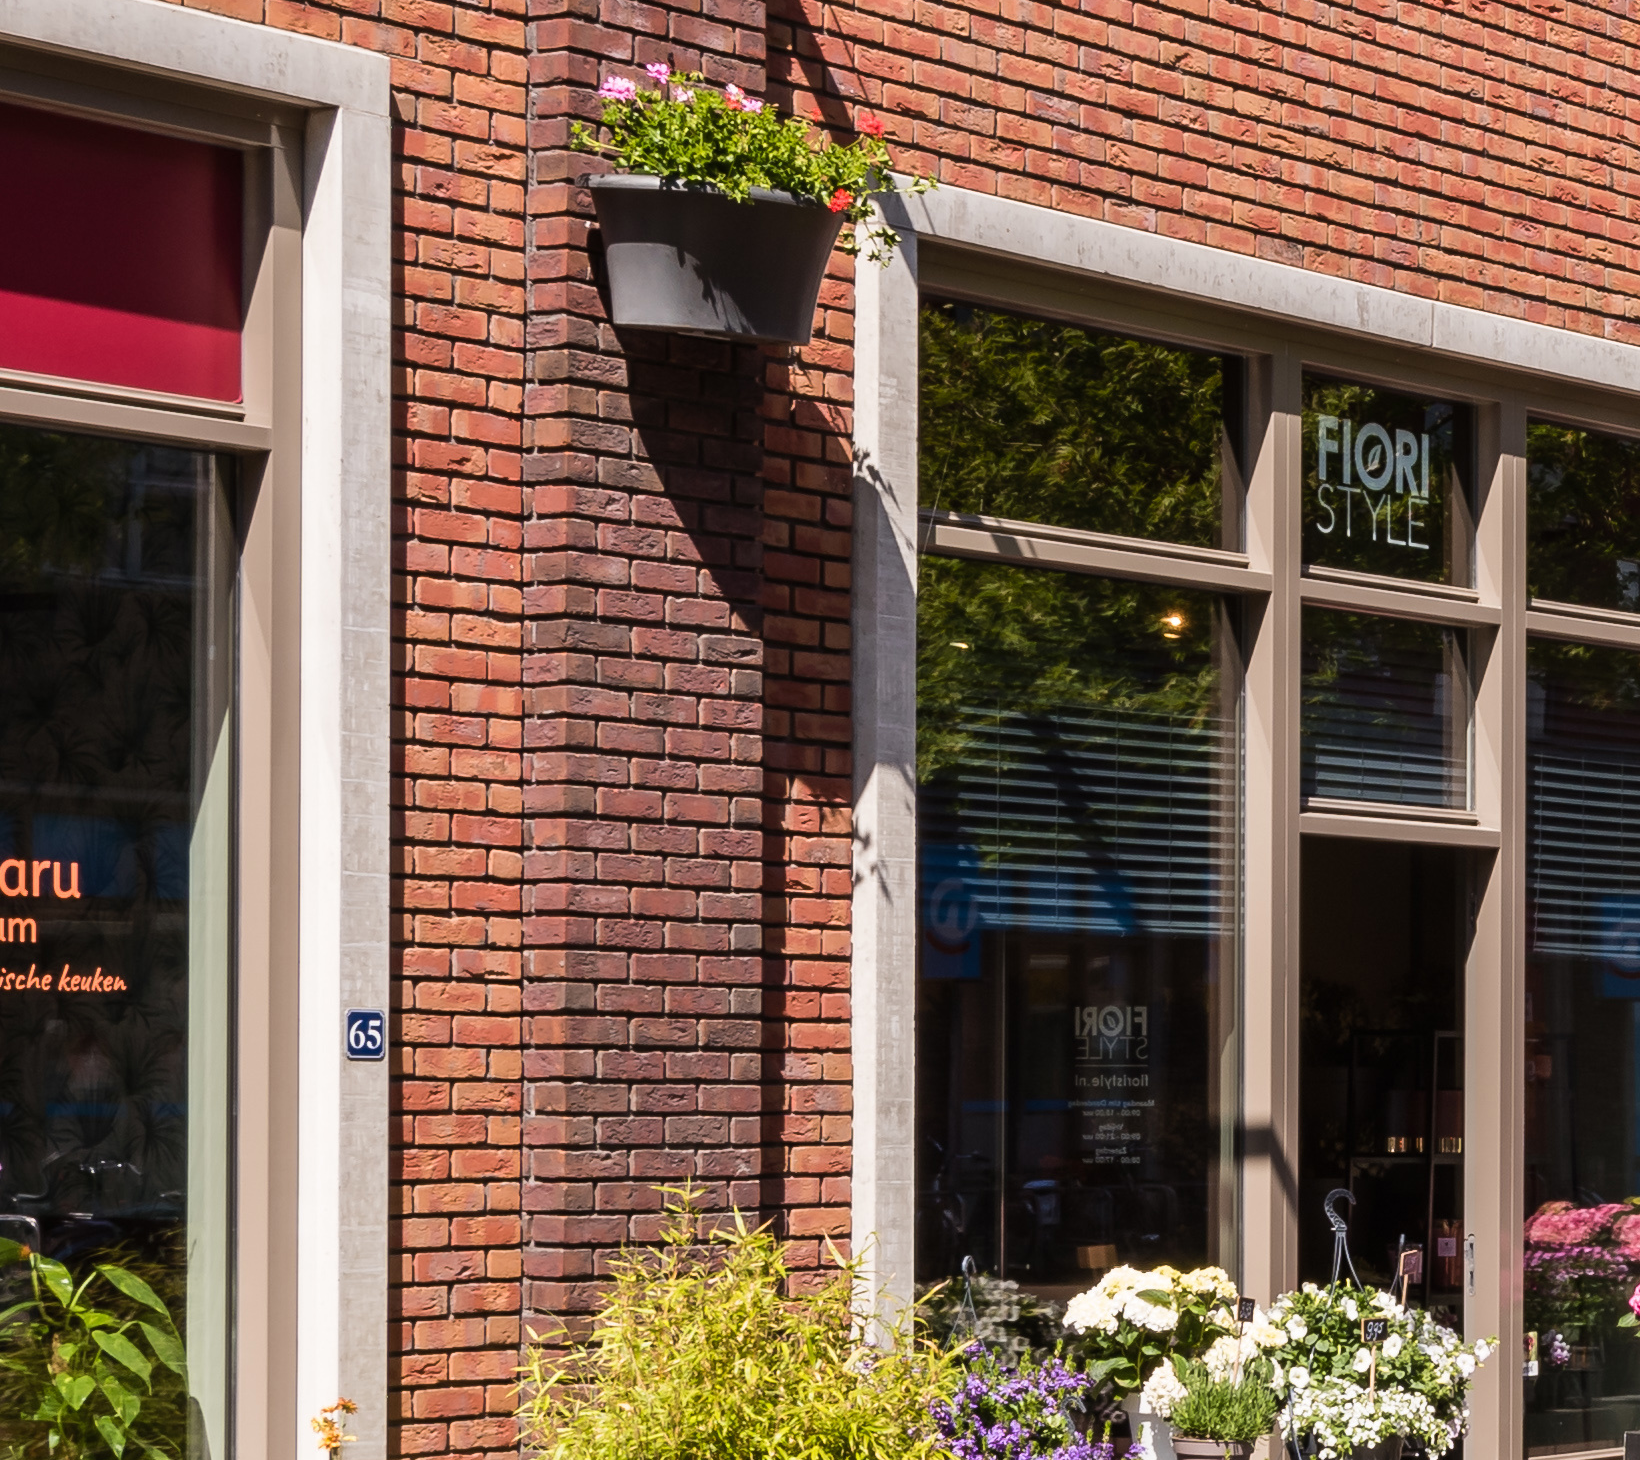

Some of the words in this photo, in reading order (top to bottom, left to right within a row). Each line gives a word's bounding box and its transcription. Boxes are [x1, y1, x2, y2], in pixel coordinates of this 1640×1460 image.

[1318, 413, 1429, 499] FIORI
[1316, 483, 1430, 550] STYLE
[57, 963, 127, 993] keuken
[349, 1020, 381, 1049] 65
